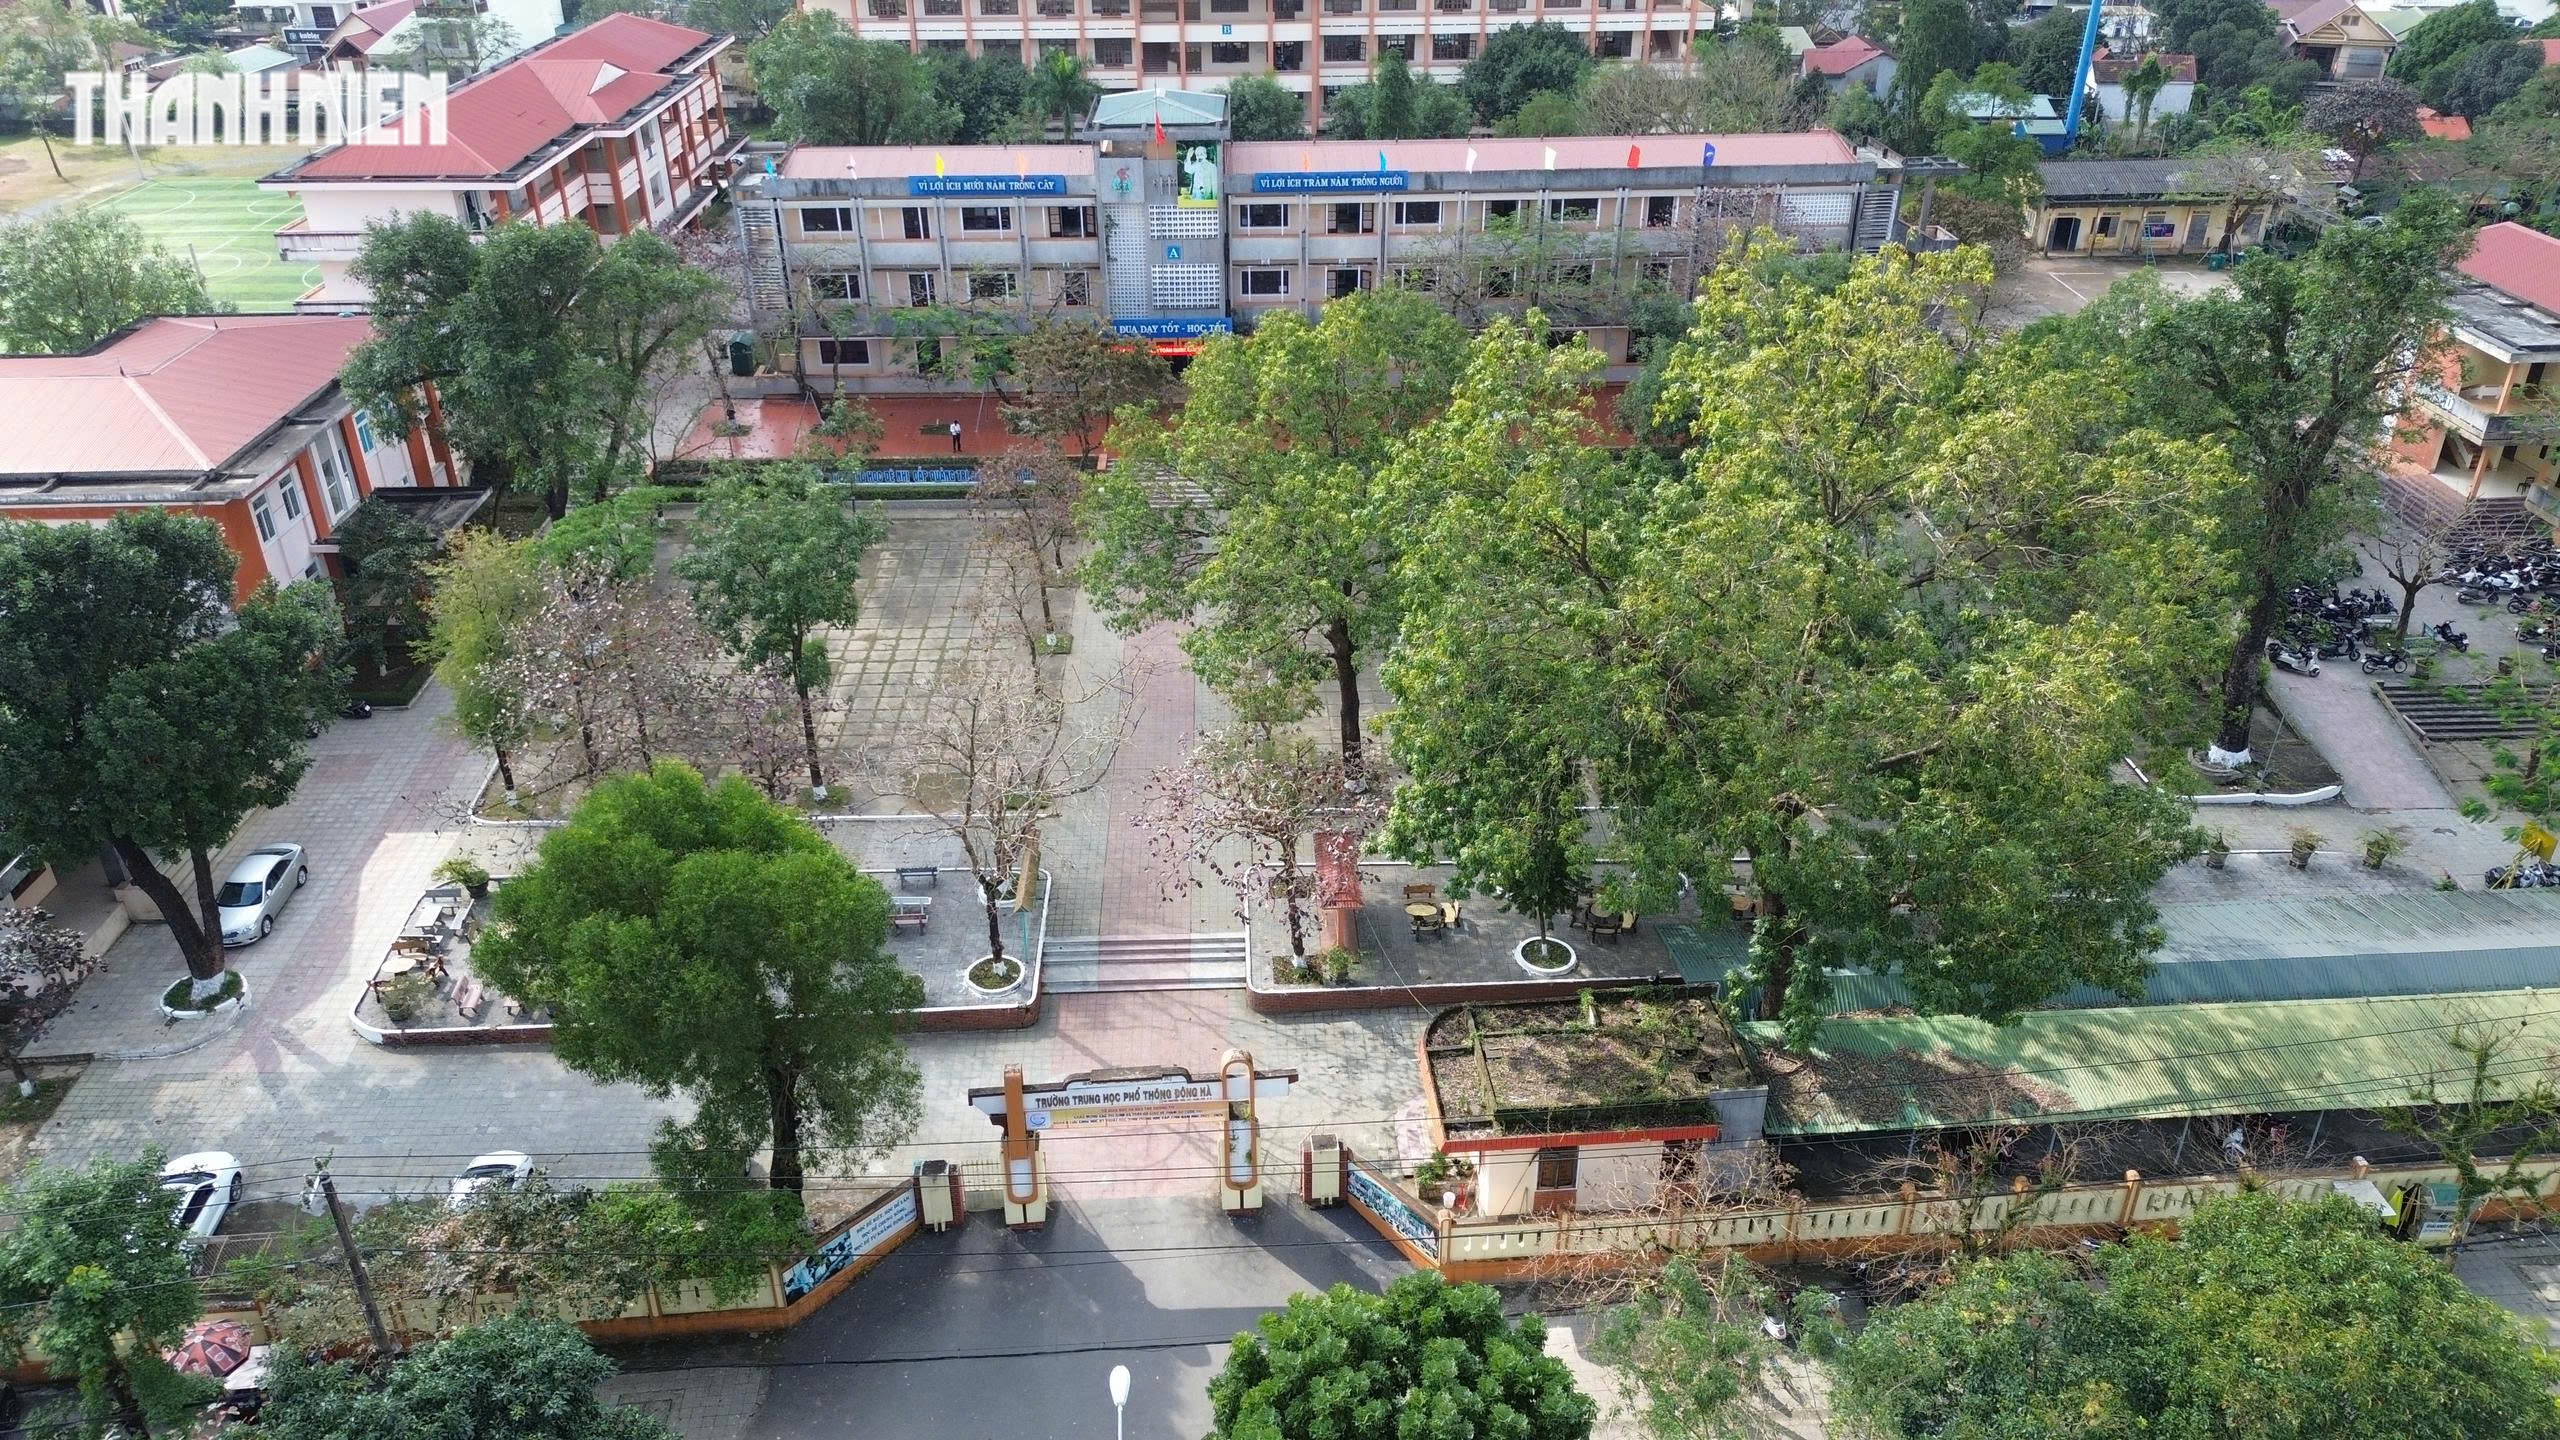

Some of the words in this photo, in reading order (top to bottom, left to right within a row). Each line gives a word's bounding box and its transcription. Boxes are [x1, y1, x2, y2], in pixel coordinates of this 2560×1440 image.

[918, 179, 928, 191] VÌ
[930, 180, 944, 192] LỢI
[946, 179, 961, 191] ÍCH
[963, 179, 984, 191] MƯỜI
[986, 179, 1006, 191] NĂM
[1009, 178, 1036, 190] TRỒNG
[1037, 179, 1055, 190] CÂY
[1260, 175, 1270, 188] VÌ
[1271, 177, 1285, 190] LỢI
[1287, 175, 1301, 188] ÍCH
[1302, 175, 1329, 187] TRĂM
[1330, 175, 1349, 187] NĂM
[1351, 173, 1377, 187] TRỒNG
[1379, 174, 1403, 186] NGƯỜI
[1119, 325, 1138, 334] ĐUA
[1160, 320, 1180, 333] TỐT
[1035, 1092, 1070, 1109] TRƯỜNG
[1072, 1094, 1101, 1107] TRUNG
[1103, 1091, 1121, 1106] HỌC
[1123, 1086, 1141, 1102] PHỔ
[1142, 1088, 1172, 1100] THÔNG
[1174, 1086, 1198, 1099] ĐÔNG
[1199, 1084, 1213, 1097] HÀ
